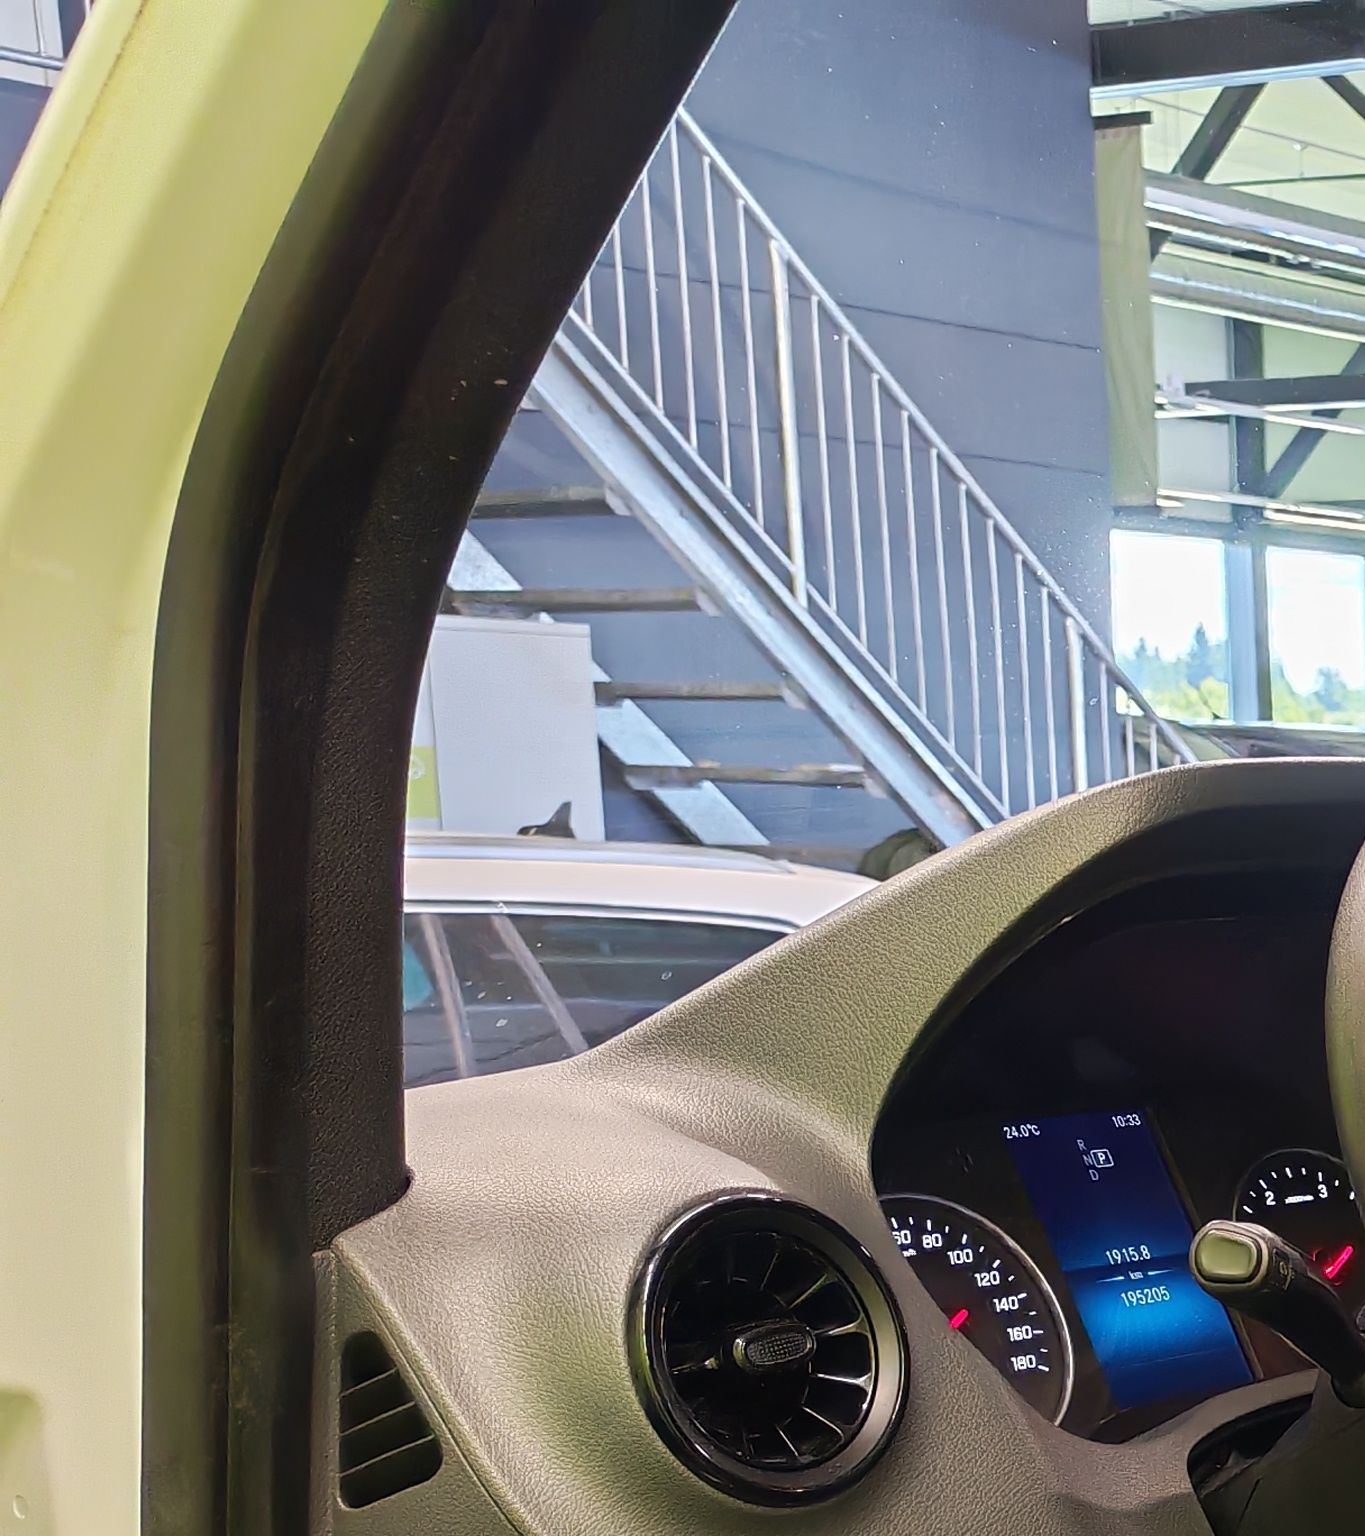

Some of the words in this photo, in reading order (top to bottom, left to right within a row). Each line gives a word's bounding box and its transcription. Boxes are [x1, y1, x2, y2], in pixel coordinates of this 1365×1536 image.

[1112, 1113, 1142, 1129] 10:33
[1003, 1123, 1041, 1139] 24.0°C
[1077, 1139, 1087, 1151] R
[1083, 1154, 1094, 1167] N
[1098, 1152, 1106, 1165] P
[1089, 1169, 1099, 1181] D
[1264, 1191, 1276, 1206] 2
[1317, 1184, 1329, 1199] 3
[922, 1233, 943, 1249] 80
[947, 1249, 974, 1265] 100
[1105, 1245, 1151, 1265] 1915.8
[974, 1270, 1001, 1287] 120
[993, 1296, 1020, 1312] 140
[1121, 1285, 1171, 1308] 195205
[1007, 1325, 1033, 1342] 160
[1010, 1355, 1037, 1372] 180
